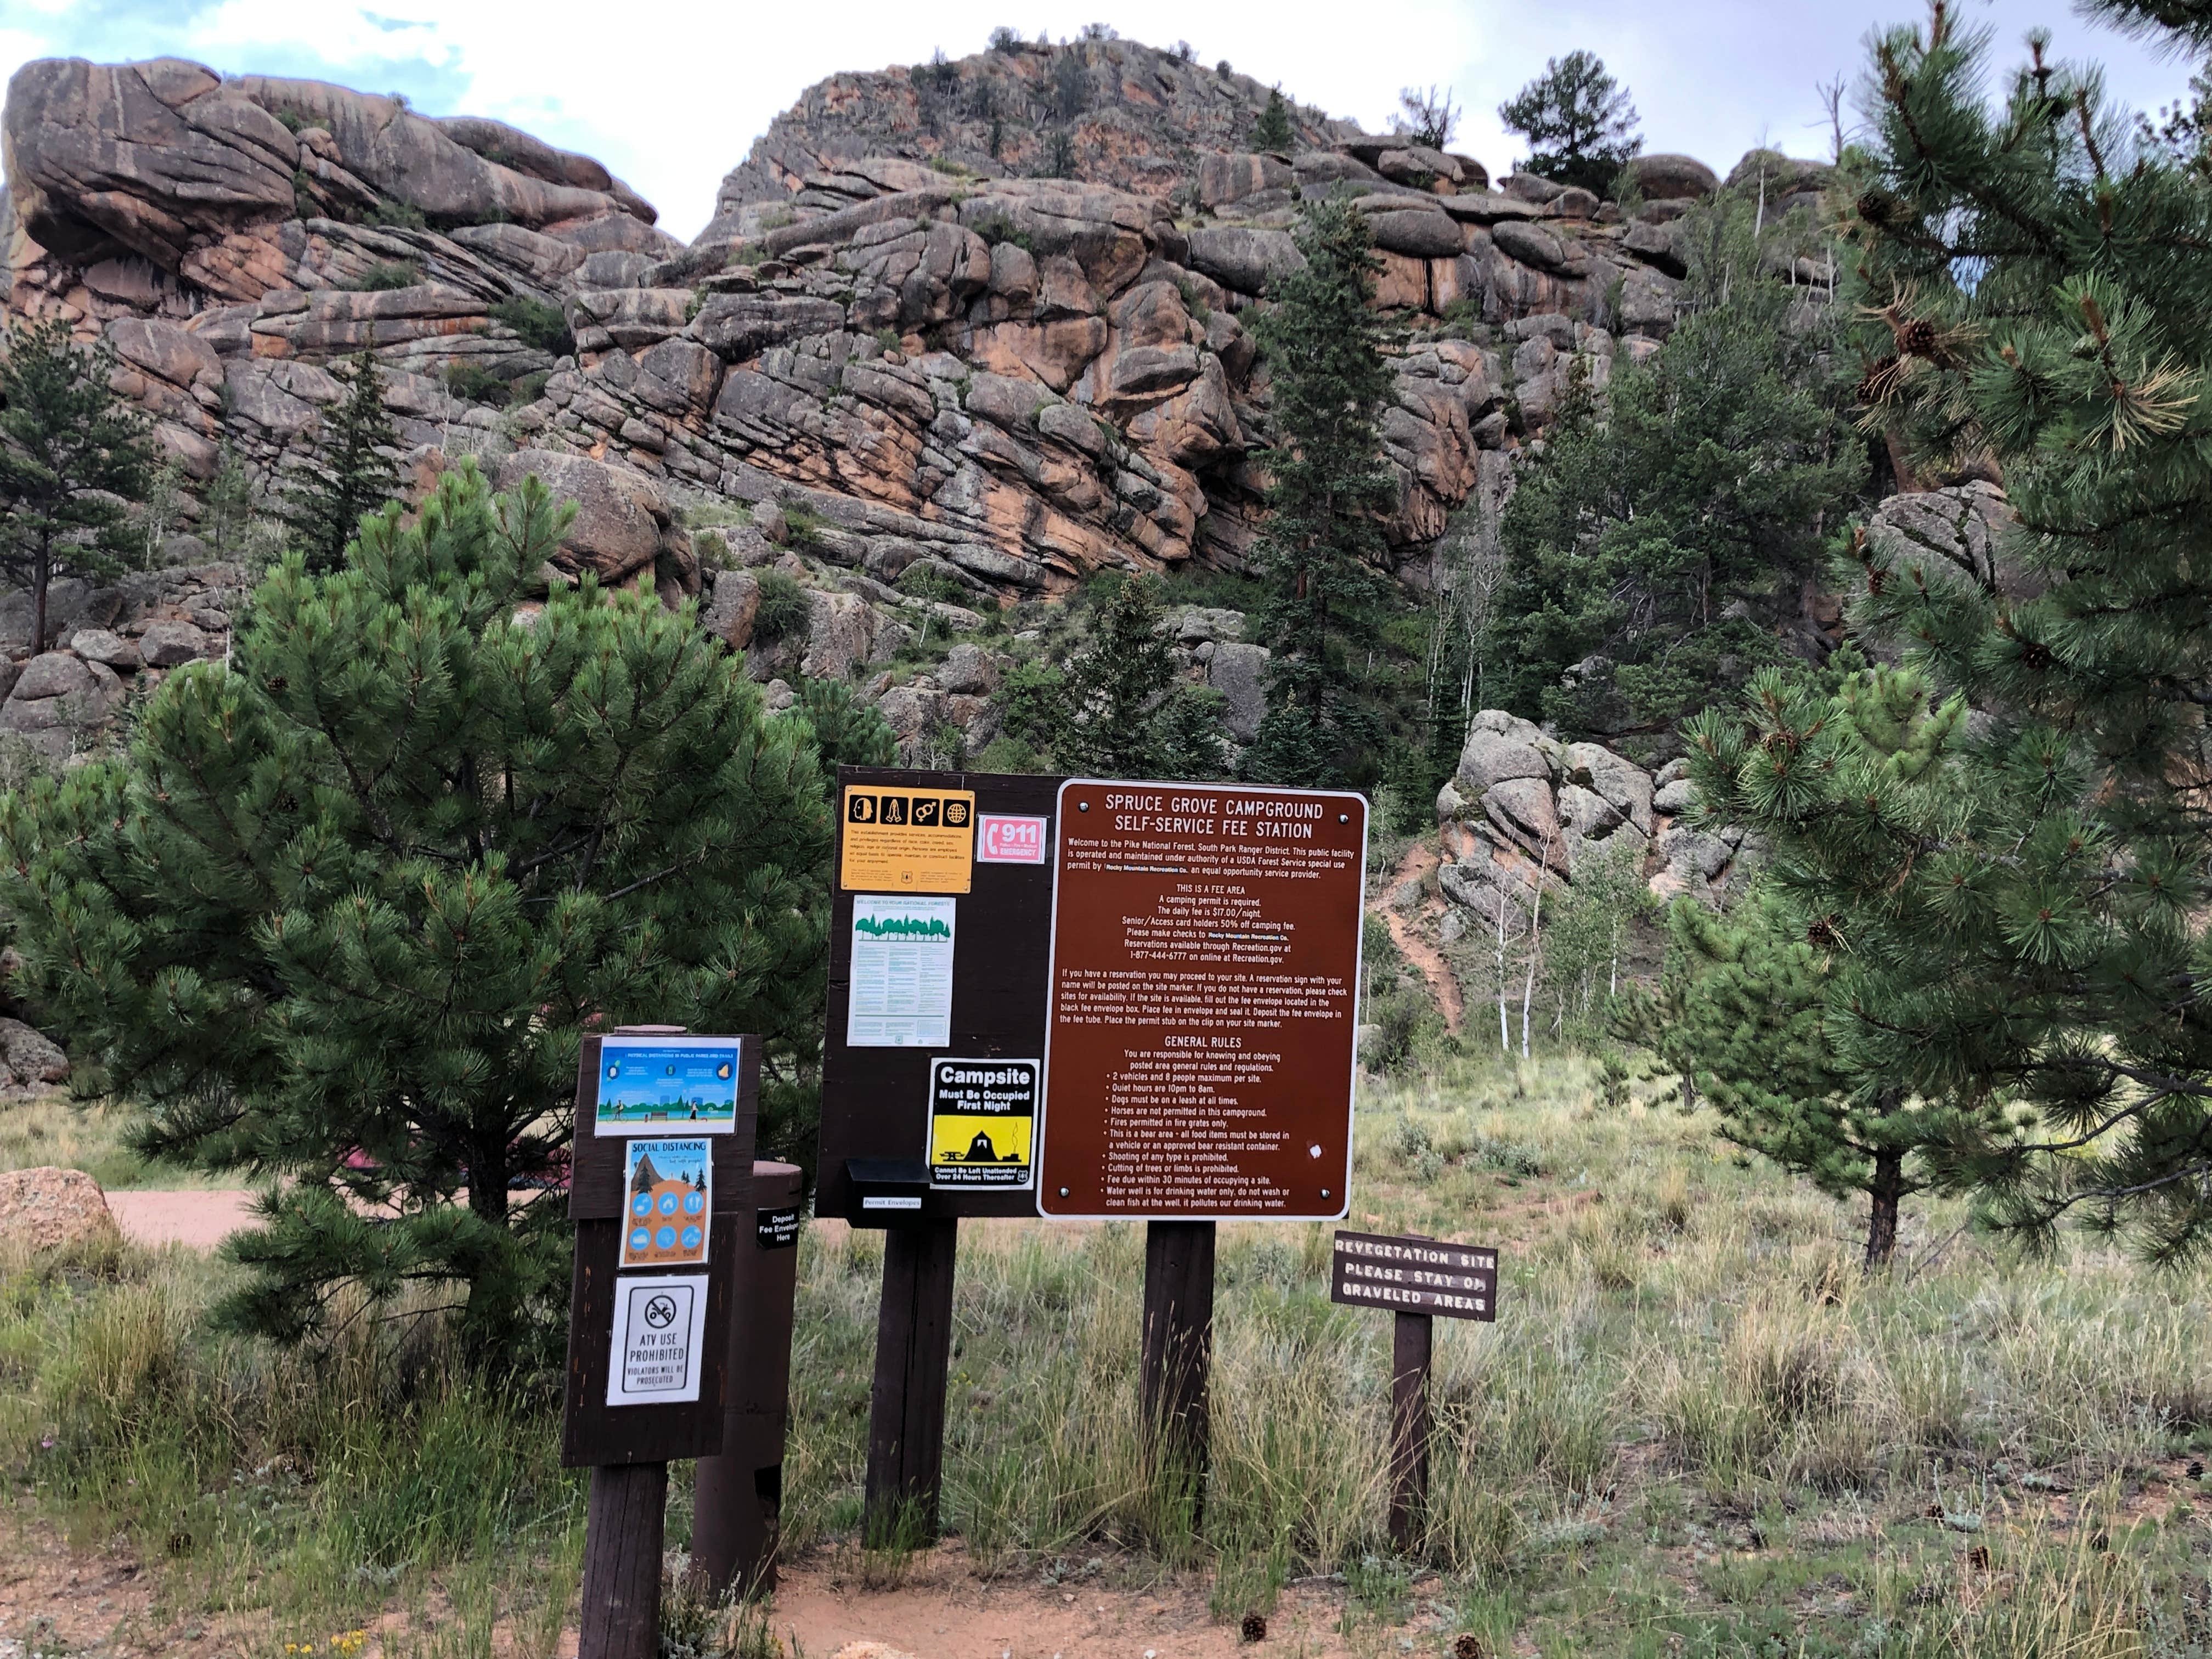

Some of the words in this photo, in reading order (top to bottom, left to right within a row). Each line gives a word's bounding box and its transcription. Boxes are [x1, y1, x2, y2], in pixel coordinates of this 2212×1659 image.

[1105, 794, 1163, 811] SPRUCE
[1171, 797, 1217, 814] GROVE
[1226, 799, 1323, 819] CAMPGROUND
[1002, 823, 1036, 843] 911
[1115, 815, 1214, 834] SELF-SERVICE
[1222, 820, 1248, 836] FEE
[1256, 821, 1312, 839] STATION
[1000, 848, 1036, 856] EMERGENCY
[1068, 837, 1099, 847] Welcome
[1101, 839, 1108, 847] to
[1110, 839, 1122, 848] the
[1124, 839, 1140, 849] Pike
[1142, 840, 1171, 850] National
[1198, 843, 1218, 852] South
[1220, 844, 1236, 853] Park
[1238, 844, 1263, 856] Ranger
[1265, 845, 1290, 855] District.
[1293, 847, 1306, 856] This
[1308, 848, 1329, 857] public
[1331, 848, 1355, 860] facility
[1068, 849, 1074, 857] is
[1076, 850, 1107, 859] operated
[1108, 851, 1122, 860] and
[1124, 851, 1163, 861] maintained
[1165, 854, 1186, 862] under
[1187, 854, 1219, 865] authority
[1221, 855, 1228, 864] of
[1237, 855, 1256, 865] USDA
[1258, 856, 1279, 866] Forest
[1280, 857, 1306, 867] Service
[1308, 859, 1331, 869] special
[1176, 884, 1193, 893] THIS
[1195, 884, 1202, 893] IS
[1204, 884, 1209, 893] A
[1211, 885, 1224, 894] FEE
[1226, 885, 1245, 895] AREA
[1159, 895, 1164, 903] A
[1166, 895, 1196, 906] camping
[1198, 896, 1221, 906] permit
[1223, 897, 1229, 906] is
[1231, 898, 1261, 907] required.
[1158, 905, 1170, 915] The
[1172, 906, 1189, 917] daily
[1192, 907, 1203, 916] fee
[1204, 907, 1210, 916] is
[1122, 916, 1174, 927] Senior/Access
[1176, 918, 1191, 927] card
[1193, 918, 1218, 928] holders
[1221, 919, 1238, 928] 50%
[1240, 920, 1250, 929] off
[1251, 921, 1281, 932] camping
[1283, 921, 1295, 930] fee.
[1130, 950, 1187, 960] 1-877-444-6777
[1200, 952, 1222, 962] online
[1223, 953, 1231, 962] at
[1232, 953, 1284, 966] Recreation.gov.
[1165, 1035, 1208, 1047] GENERAL
[1211, 1036, 1242, 1048] RULES
[1124, 1049, 1137, 1058] You
[1153, 1050, 1192, 1060] responsible
[1194, 1050, 1204, 1059] for
[1206, 1051, 1236, 1062] knowing
[1238, 1052, 1251, 1060] and
[1253, 1052, 1280, 1063] obeying
[940, 1066, 1030, 1087] Campsite
[1113, 1071, 1118, 1080] 2
[1120, 1072, 1148, 1081] vehicles
[1150, 1073, 1164, 1081] and
[1165, 1072, 1170, 1081] 8
[1172, 1073, 1196, 1083] people
[1198, 1073, 1232, 1082] maximum
[1234, 1075, 1246, 1084] per
[1248, 1074, 1261, 1083] site.
[939, 1090, 964, 1099] Must
[966, 1090, 980, 1099] Be
[983, 1090, 1030, 1102] Occupied
[957, 1100, 981, 1110] First
[984, 1101, 1011, 1112] Night
[1111, 1106, 1134, 1115] Horses
[1149, 1107, 1161, 1115] not
[1163, 1107, 1197, 1117] permitted
[1199, 1107, 1206, 1116] in
[1207, 1107, 1221, 1116] this
[1222, 1108, 1267, 1119] campground.
[633, 1143, 659, 1152] SOCIAL
[663, 1142, 706, 1151] DISTANCING
[1108, 1152, 1139, 1163] Shooting
[1142, 1152, 1149, 1161] of
[1150, 1154, 1164, 1163] any
[1166, 1153, 1182, 1163] type
[1184, 1152, 1190, 1161] is
[1192, 1153, 1228, 1163] prohibited.
[772, 1213, 794, 1224] Deposit
[759, 1226, 773, 1234] Fee
[1335, 1239, 1448, 1265] REVEGETATION
[1460, 1254, 1494, 1269] SITE
[1345, 1262, 1402, 1282] PLEASE
[1414, 1270, 1453, 1287] STAY
[1342, 1282, 1421, 1304] GRAVELED
[1434, 1294, 1486, 1311] AREAS
[639, 1334, 657, 1346] ATV
[661, 1333, 677, 1345] USE
[630, 1347, 684, 1362] PROHIBITED
[628, 1367, 659, 1375] VIOLATORS
[636, 1375, 673, 1385] PROSECUTED
